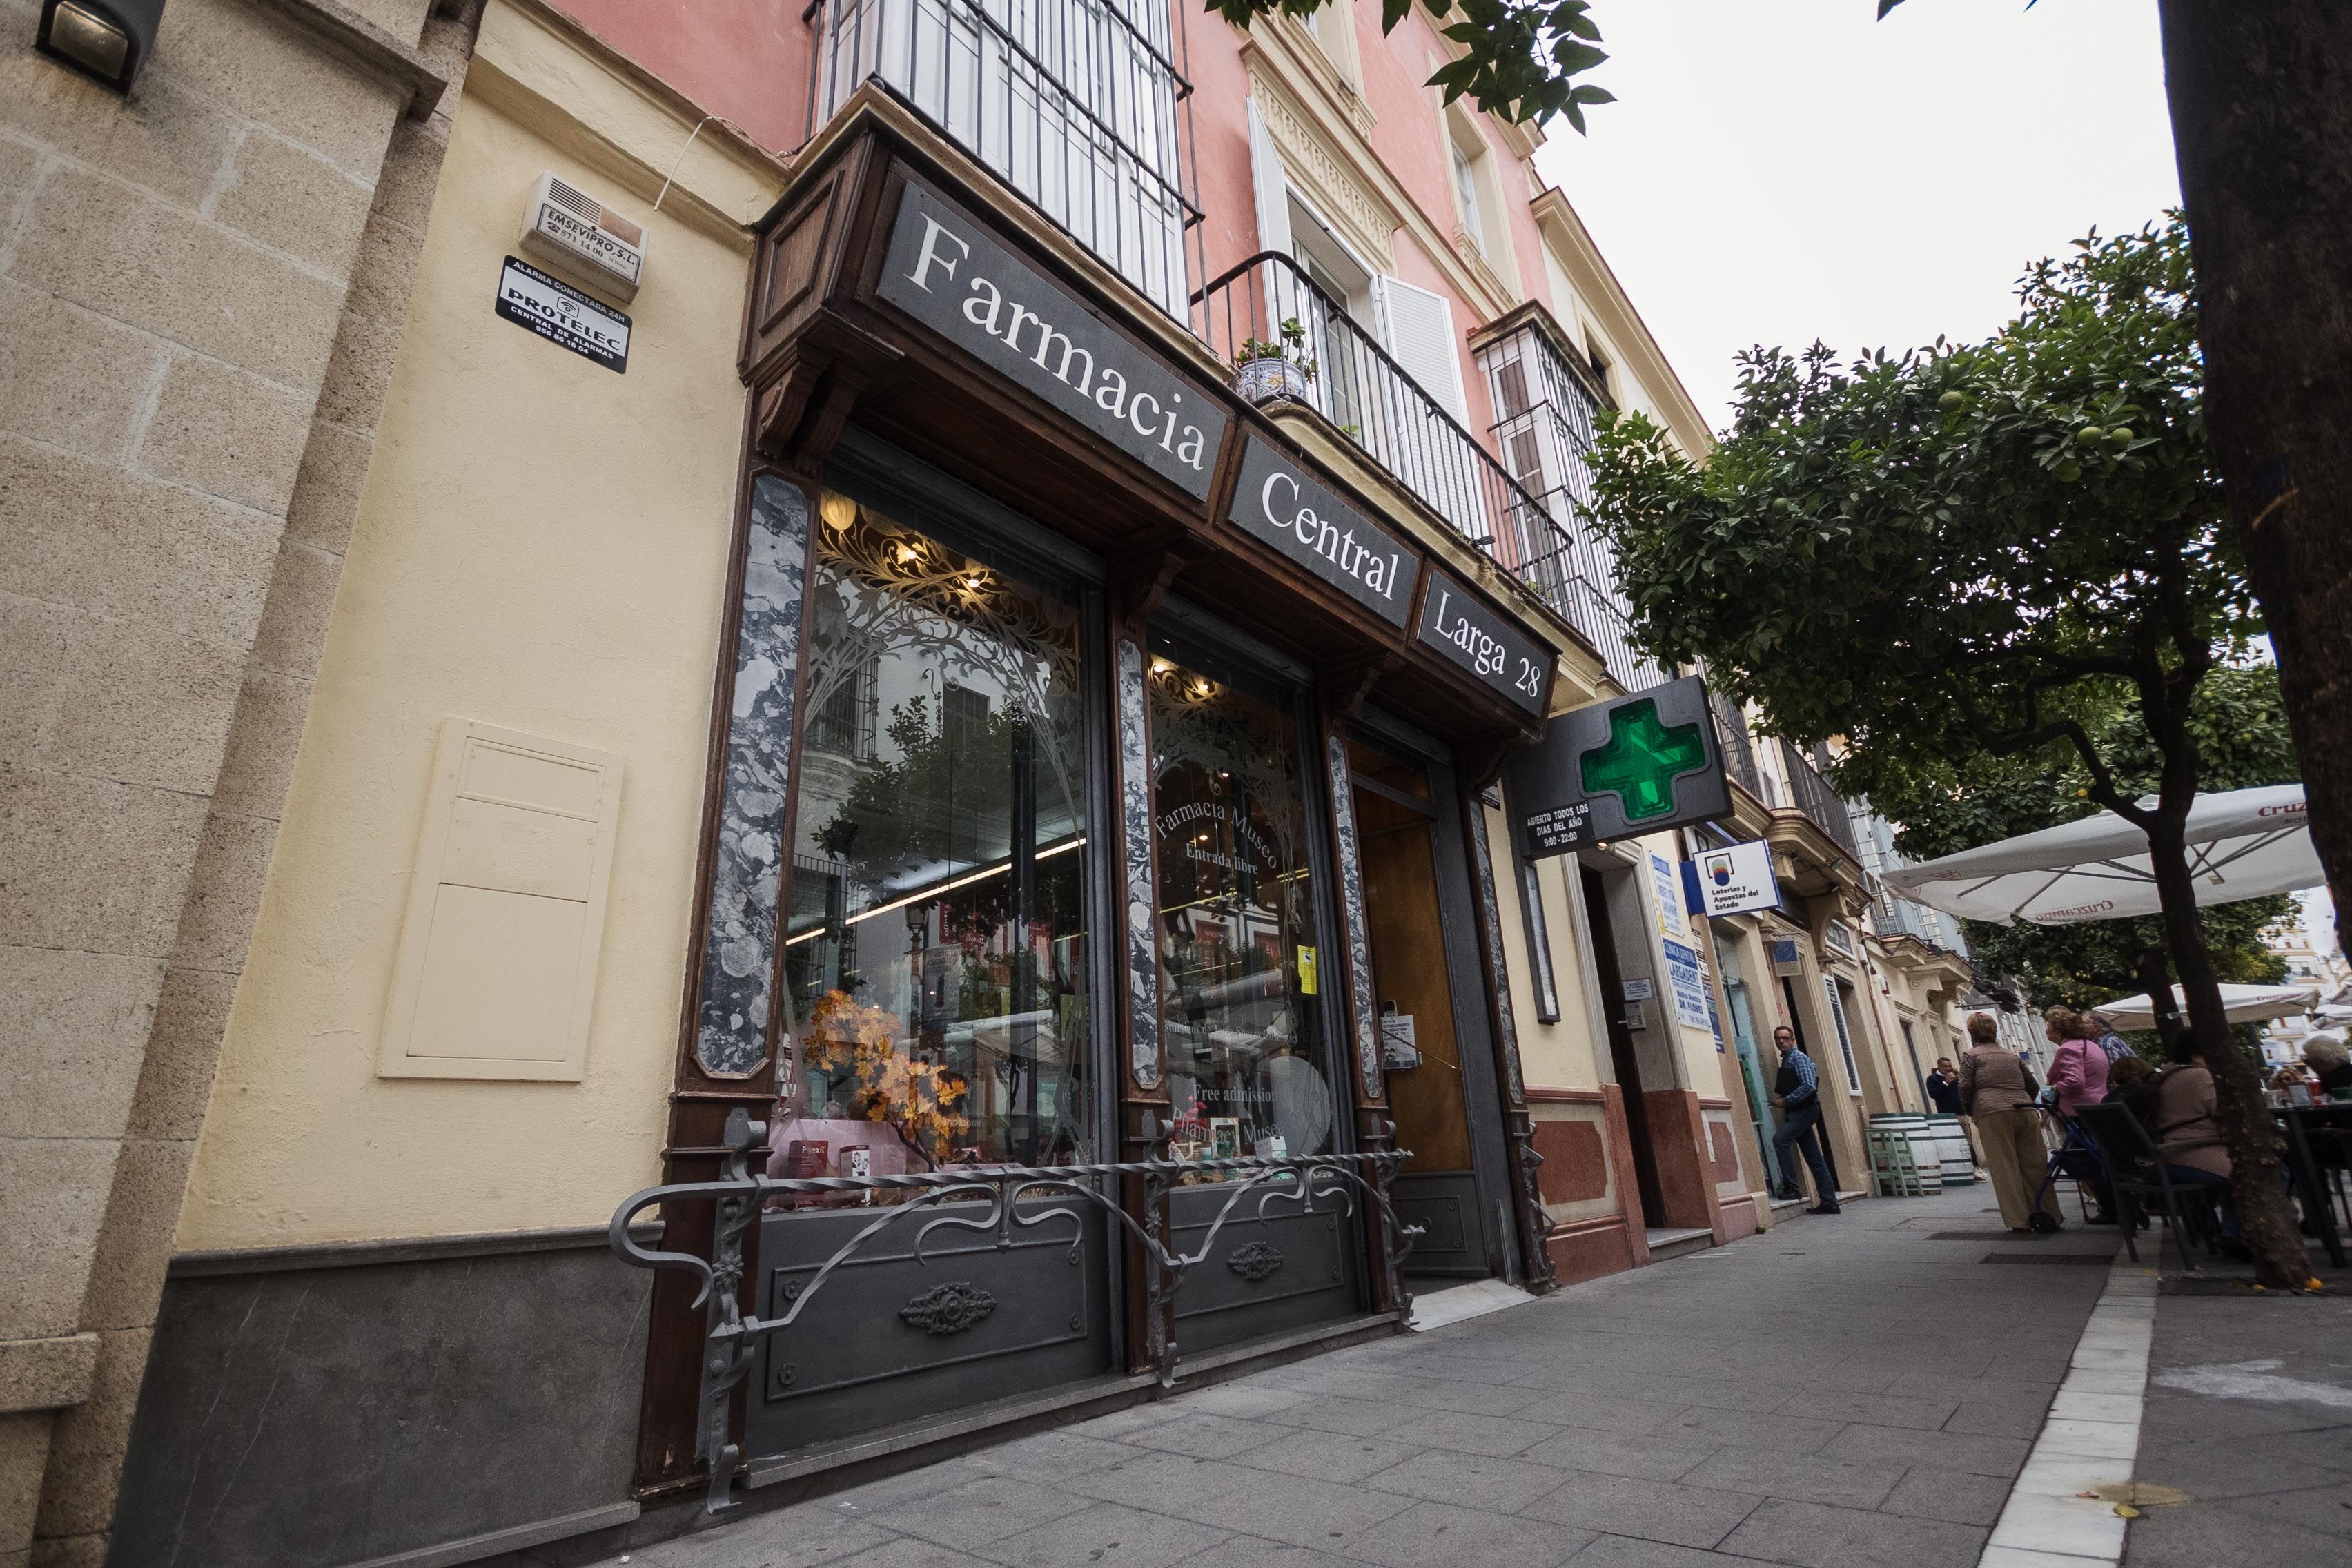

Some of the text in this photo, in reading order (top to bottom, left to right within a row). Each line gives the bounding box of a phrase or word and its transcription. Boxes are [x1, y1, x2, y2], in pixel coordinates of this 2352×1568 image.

[561, 230, 576, 242] 571
[580, 239, 590, 251] 14
[592, 248, 604, 257] 00
[513, 262, 552, 286] ALARMA
[554, 279, 607, 314] CONECTADA
[609, 310, 625, 323] 24H
[508, 287, 620, 351] PROTELEC
[511, 306, 614, 360] CENTRAL DE ALARMAS
[536, 324, 589, 355] 956 86 16 04
[903, 212, 1540, 698] Farmacia Central Larga 28
[1527, 803, 1589, 827] ABIERTO TODOS LOS
[1536, 816, 1582, 836] DIAS DEL AÑO
[1155, 801, 1277, 870] Farmacia Museo
[1544, 836, 1557, 847] 9:00
[1561, 831, 1578, 843] 22:00
[1186, 843, 1259, 875] Entrada libre
[1714, 893, 1747, 903] Apuestas
[1715, 901, 1739, 910] Estado
[1193, 1084, 1221, 1101] Free
